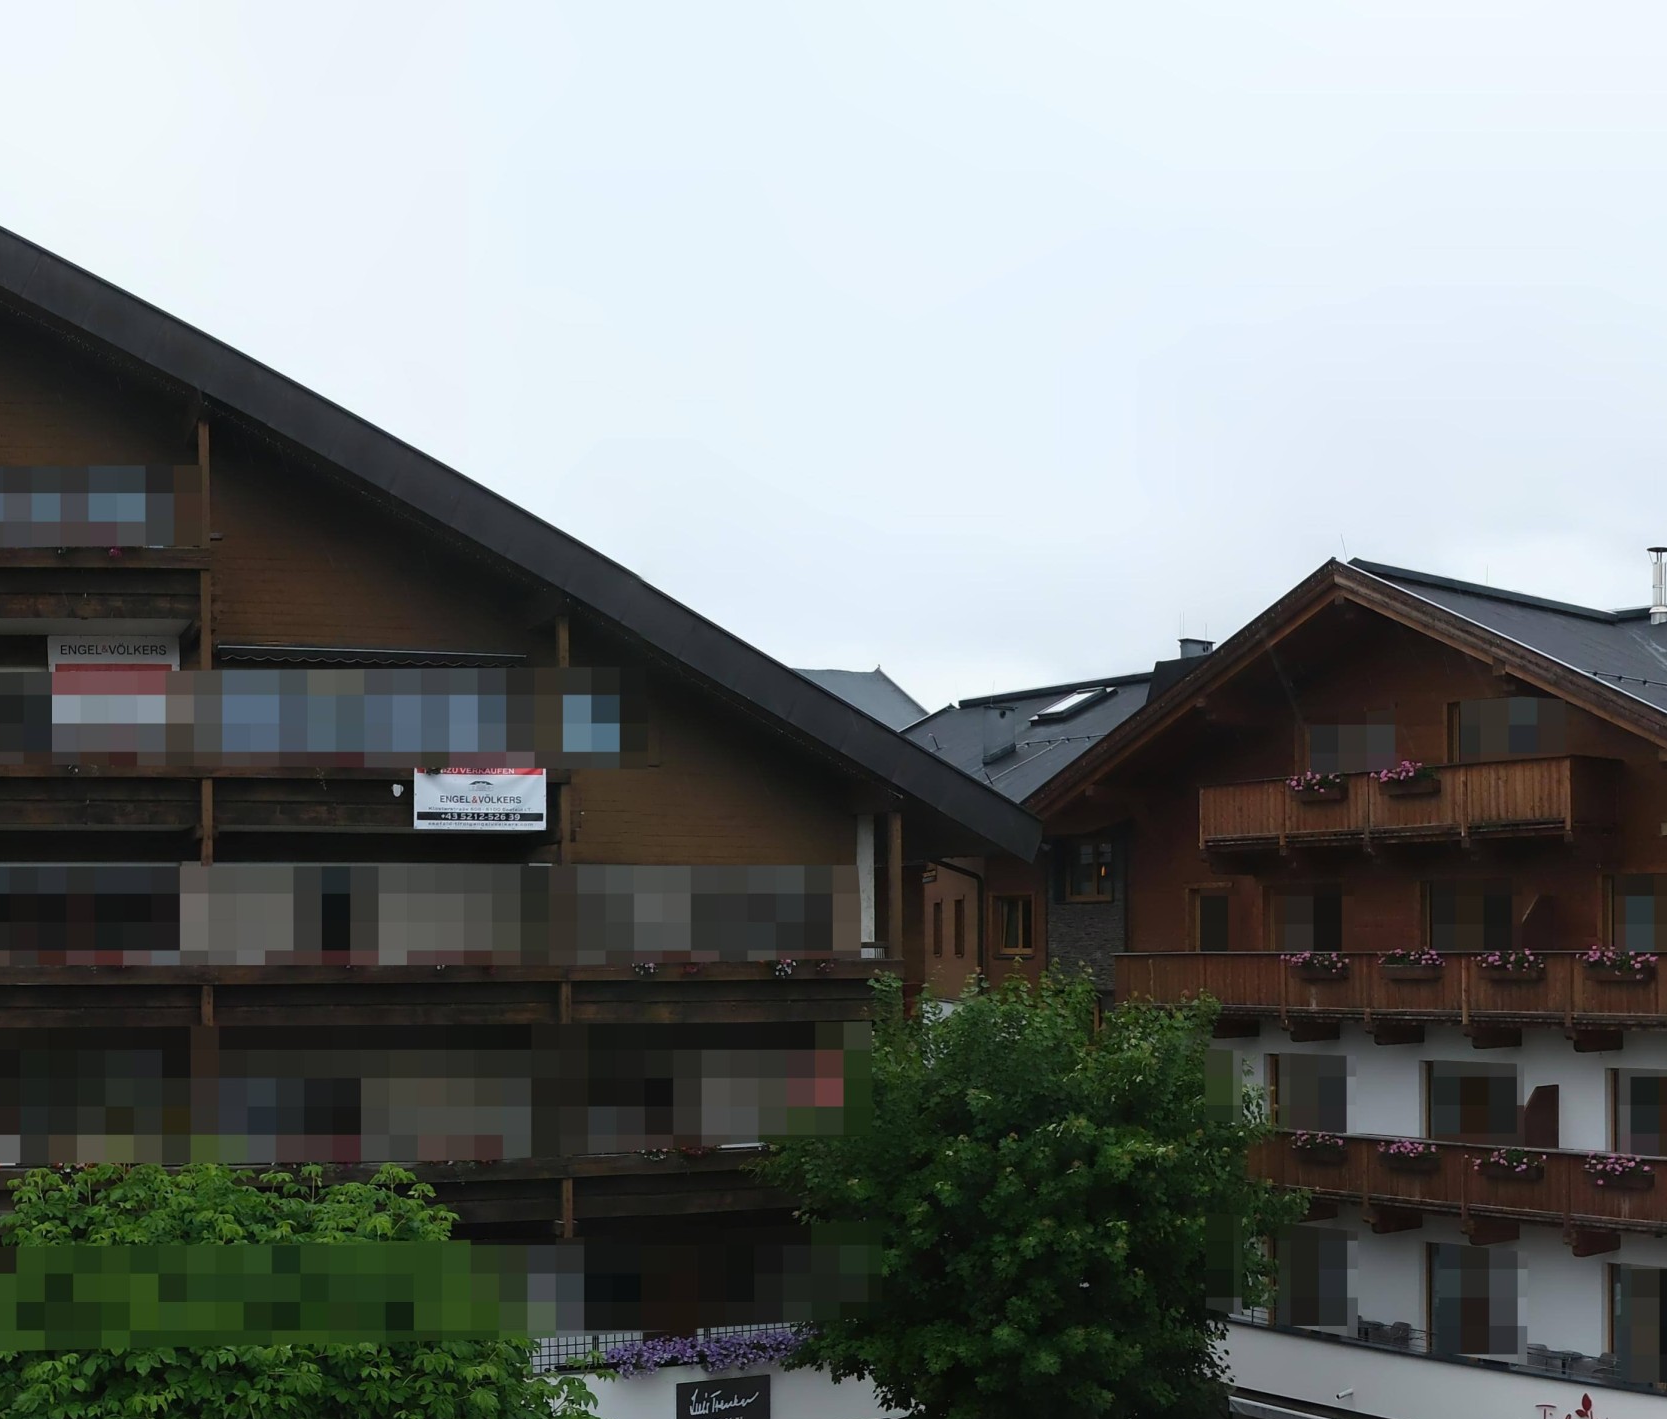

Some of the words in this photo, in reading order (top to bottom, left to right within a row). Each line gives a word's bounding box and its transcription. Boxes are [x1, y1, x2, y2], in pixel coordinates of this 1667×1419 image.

[60, 643, 167, 656] ENGEL&VÖLKERS
[460, 813, 506, 821] 5212-526
[508, 813, 520, 821] 39
